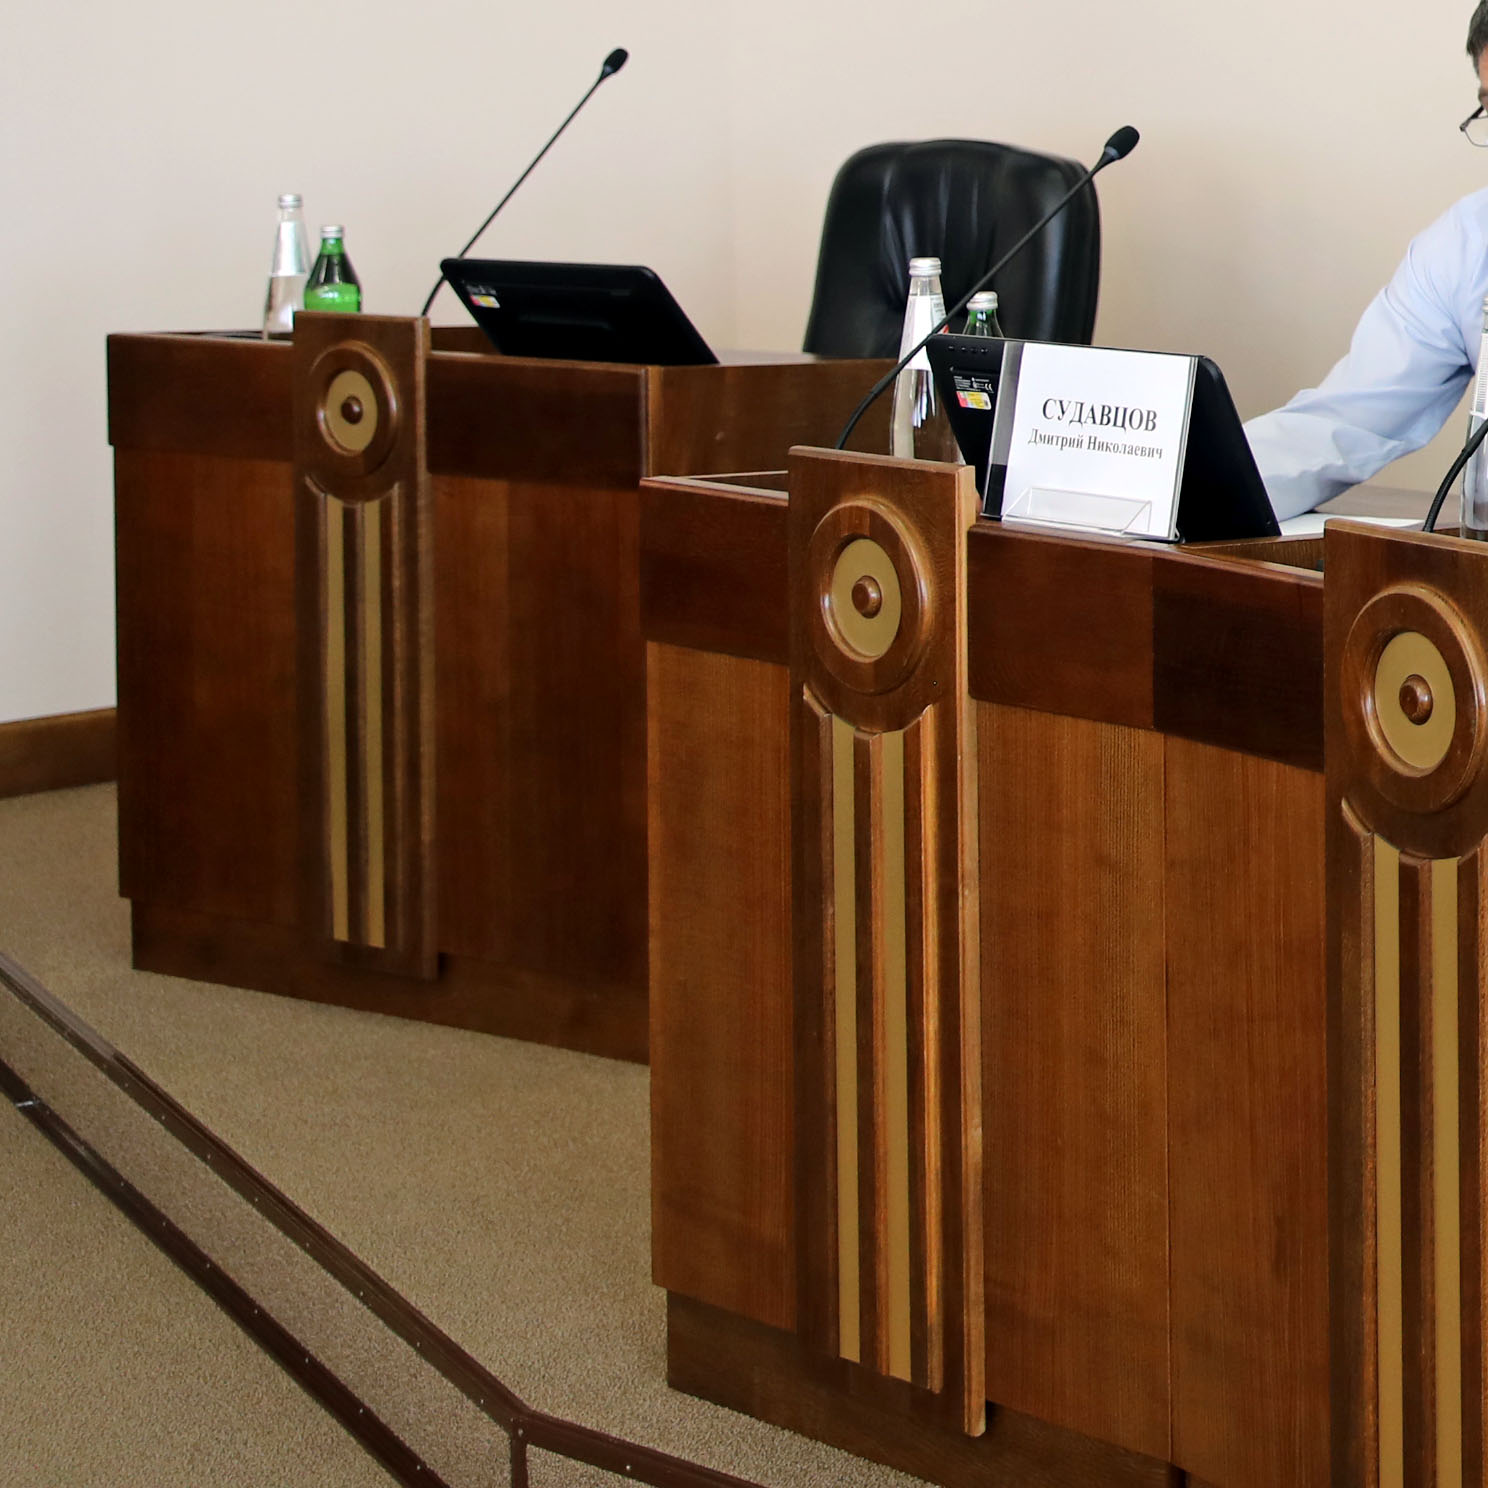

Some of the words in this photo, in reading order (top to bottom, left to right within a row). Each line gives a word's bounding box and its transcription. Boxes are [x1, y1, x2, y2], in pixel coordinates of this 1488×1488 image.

[1042, 398, 1158, 432] СУДАВЦОВ
[1028, 428, 1084, 451] Дмитрий
[1087, 435, 1163, 459] Николаевич
